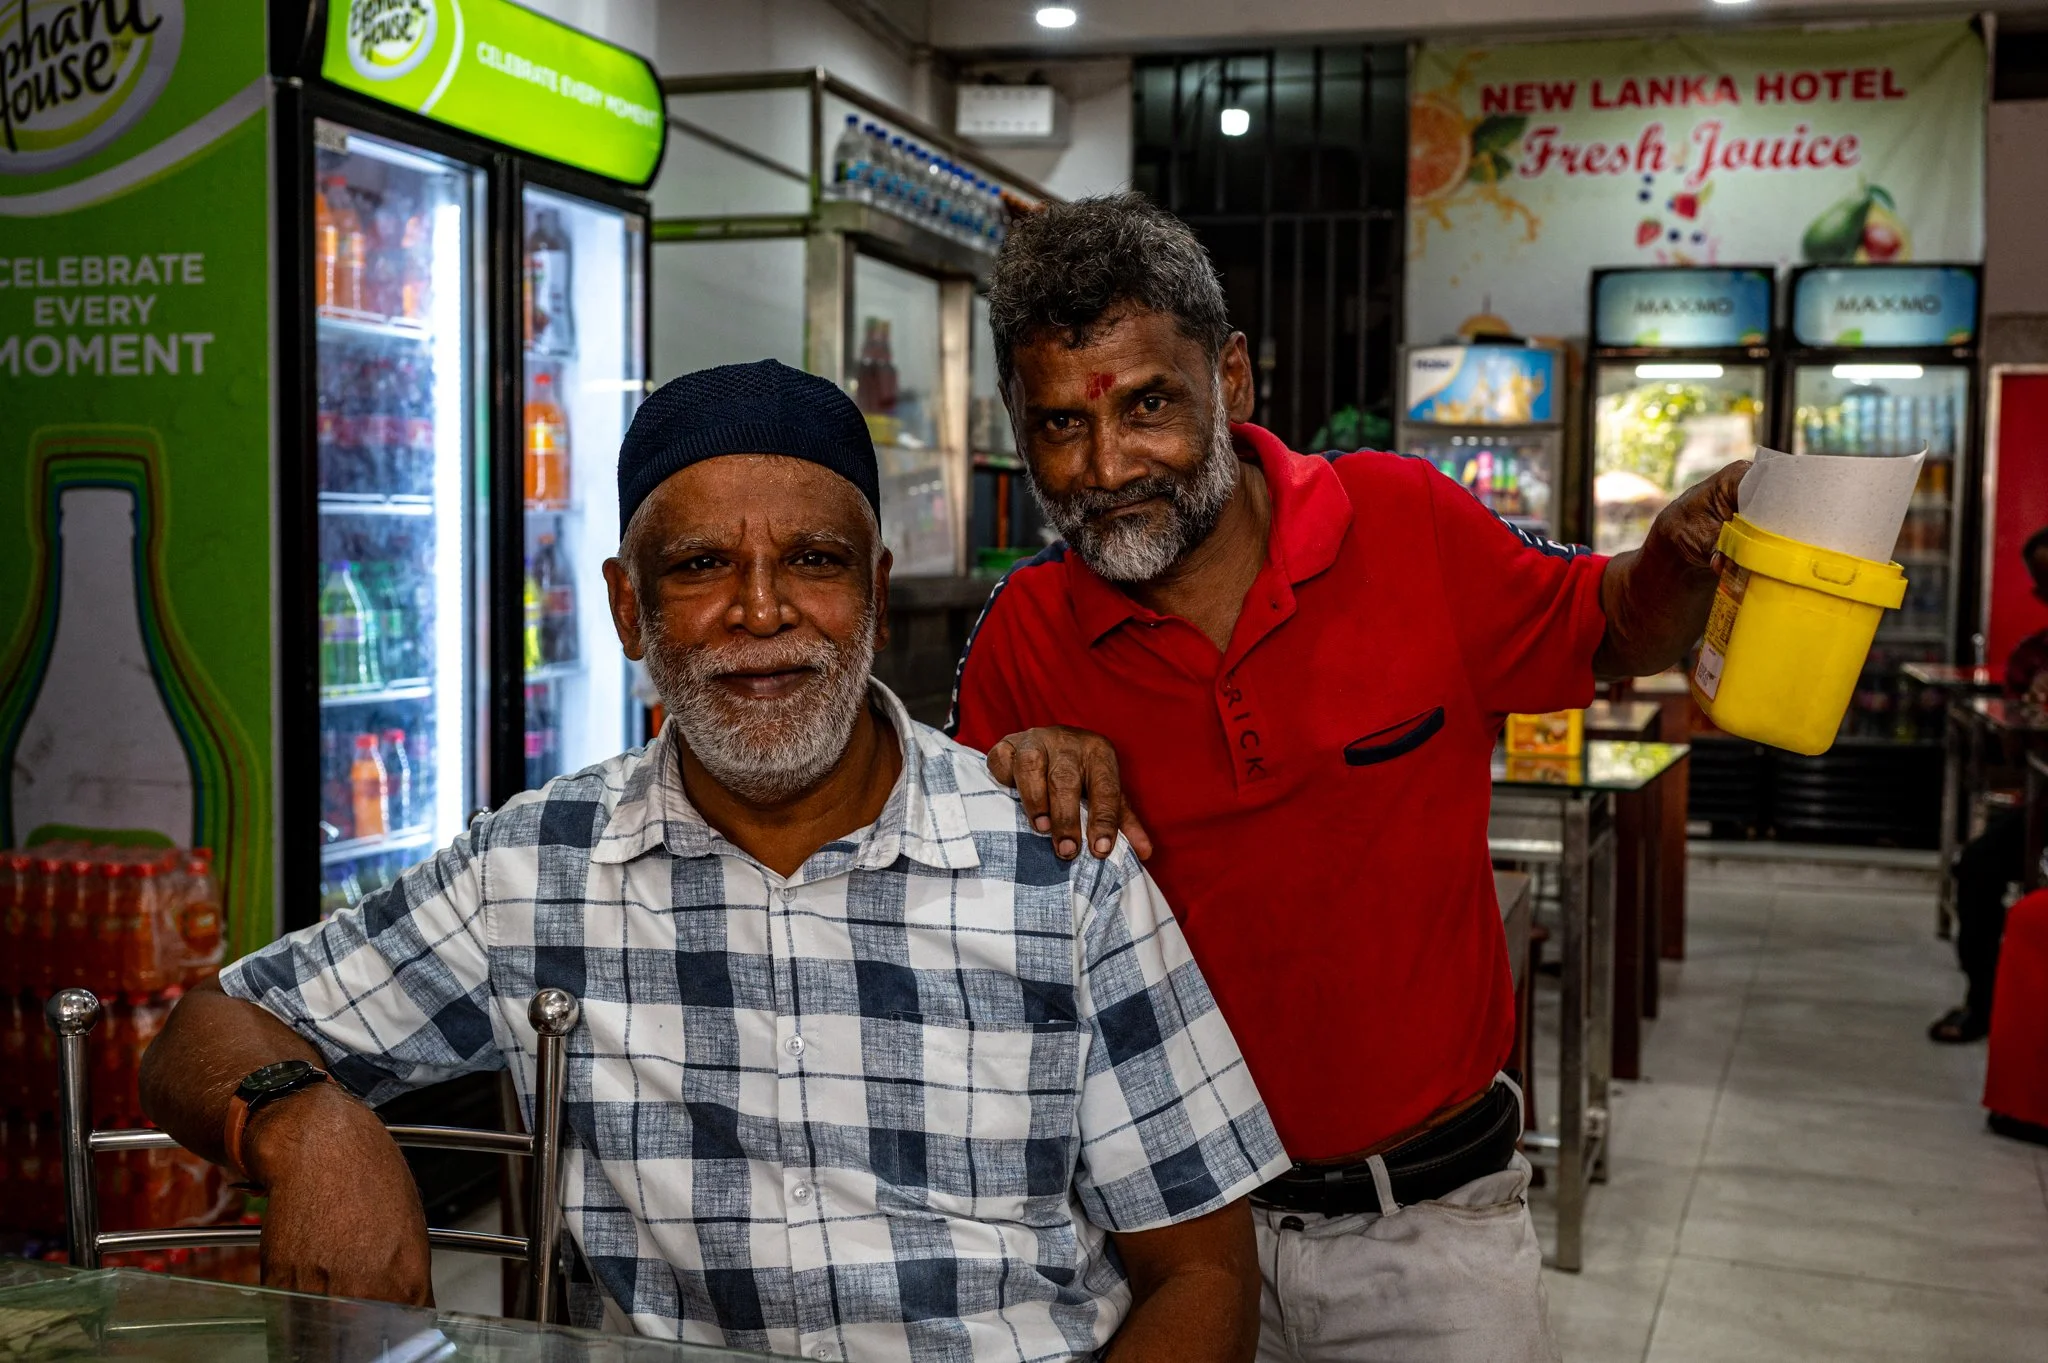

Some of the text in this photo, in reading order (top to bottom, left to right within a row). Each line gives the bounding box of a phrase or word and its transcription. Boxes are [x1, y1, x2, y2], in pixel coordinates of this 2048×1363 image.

[476, 41, 659, 128] CELEBRATE EVERY MOMENT
[1481, 68, 1907, 115] NEW LANKA HOTEL
[1517, 119, 1861, 185] Fresh Jouice
[33, 294, 157, 327] EVERY
